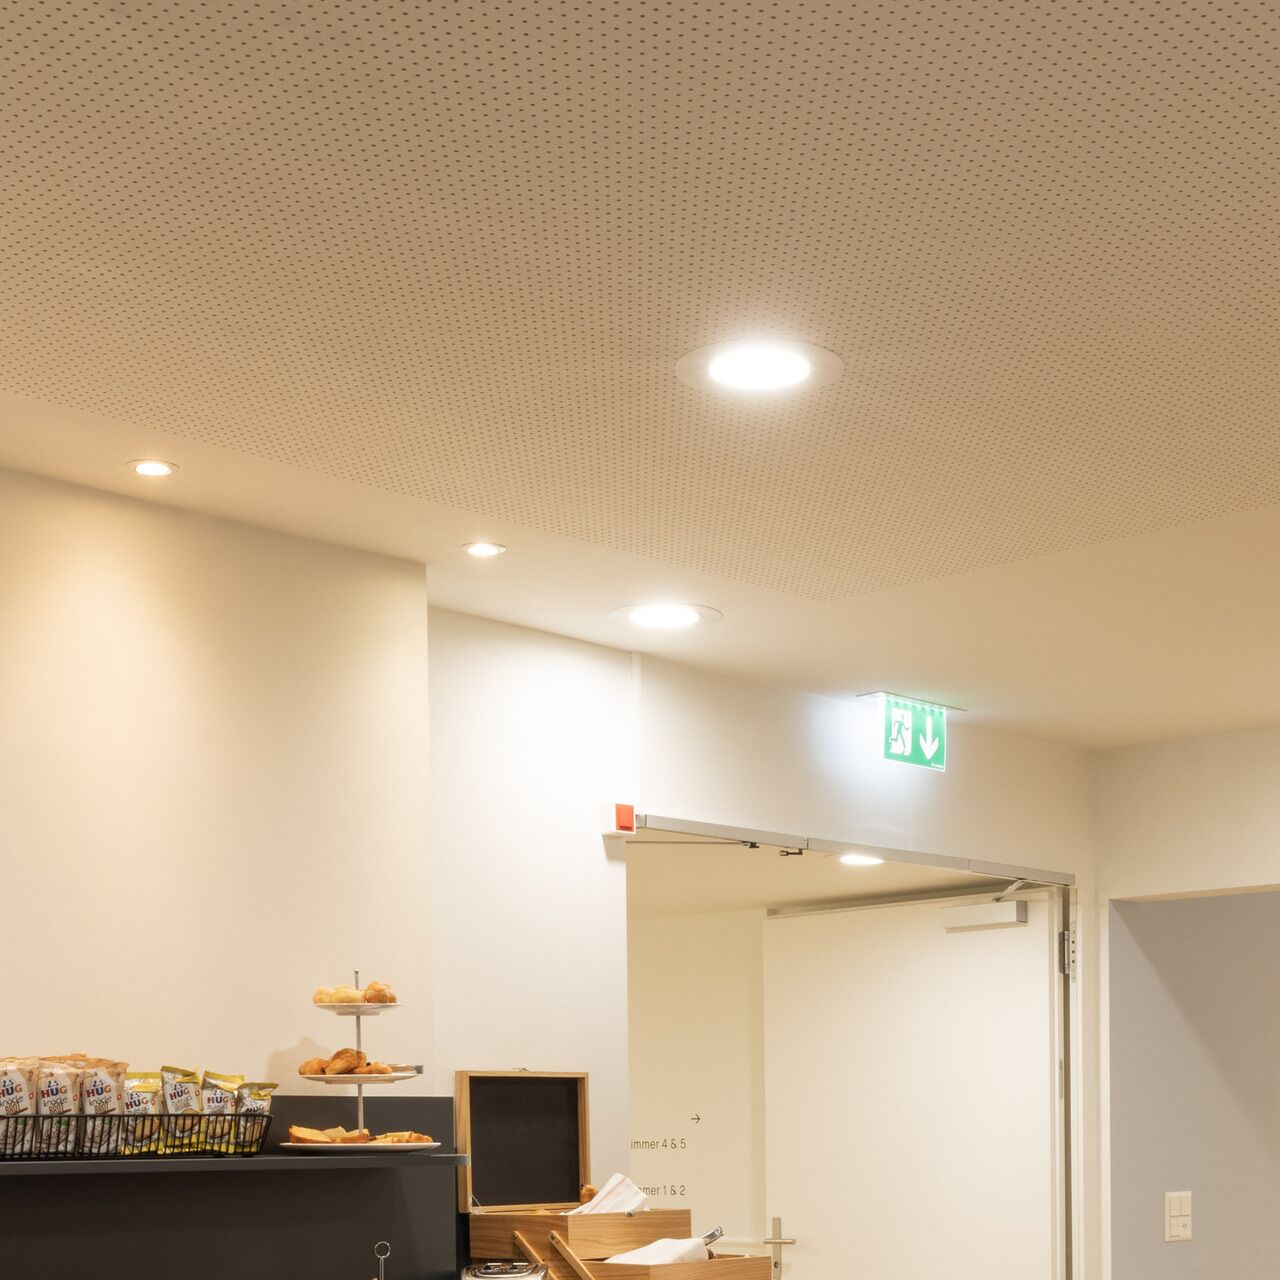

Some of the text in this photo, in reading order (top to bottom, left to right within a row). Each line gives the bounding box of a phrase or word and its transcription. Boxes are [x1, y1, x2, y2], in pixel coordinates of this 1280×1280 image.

[41, 1085, 67, 1099] HUG
[86, 1084, 111, 1098] HUG
[169, 1087, 190, 1100] HUG
[125, 1096, 148, 1110] HUG
[207, 1095, 229, 1104] HUG
[661, 1139, 668, 1149] 4
[670, 1138, 677, 1150] &
[680, 1138, 687, 1150] 5
[663, 1185, 667, 1196] 1
[670, 1184, 677, 1196] &
[679, 1184, 686, 1196] 2
